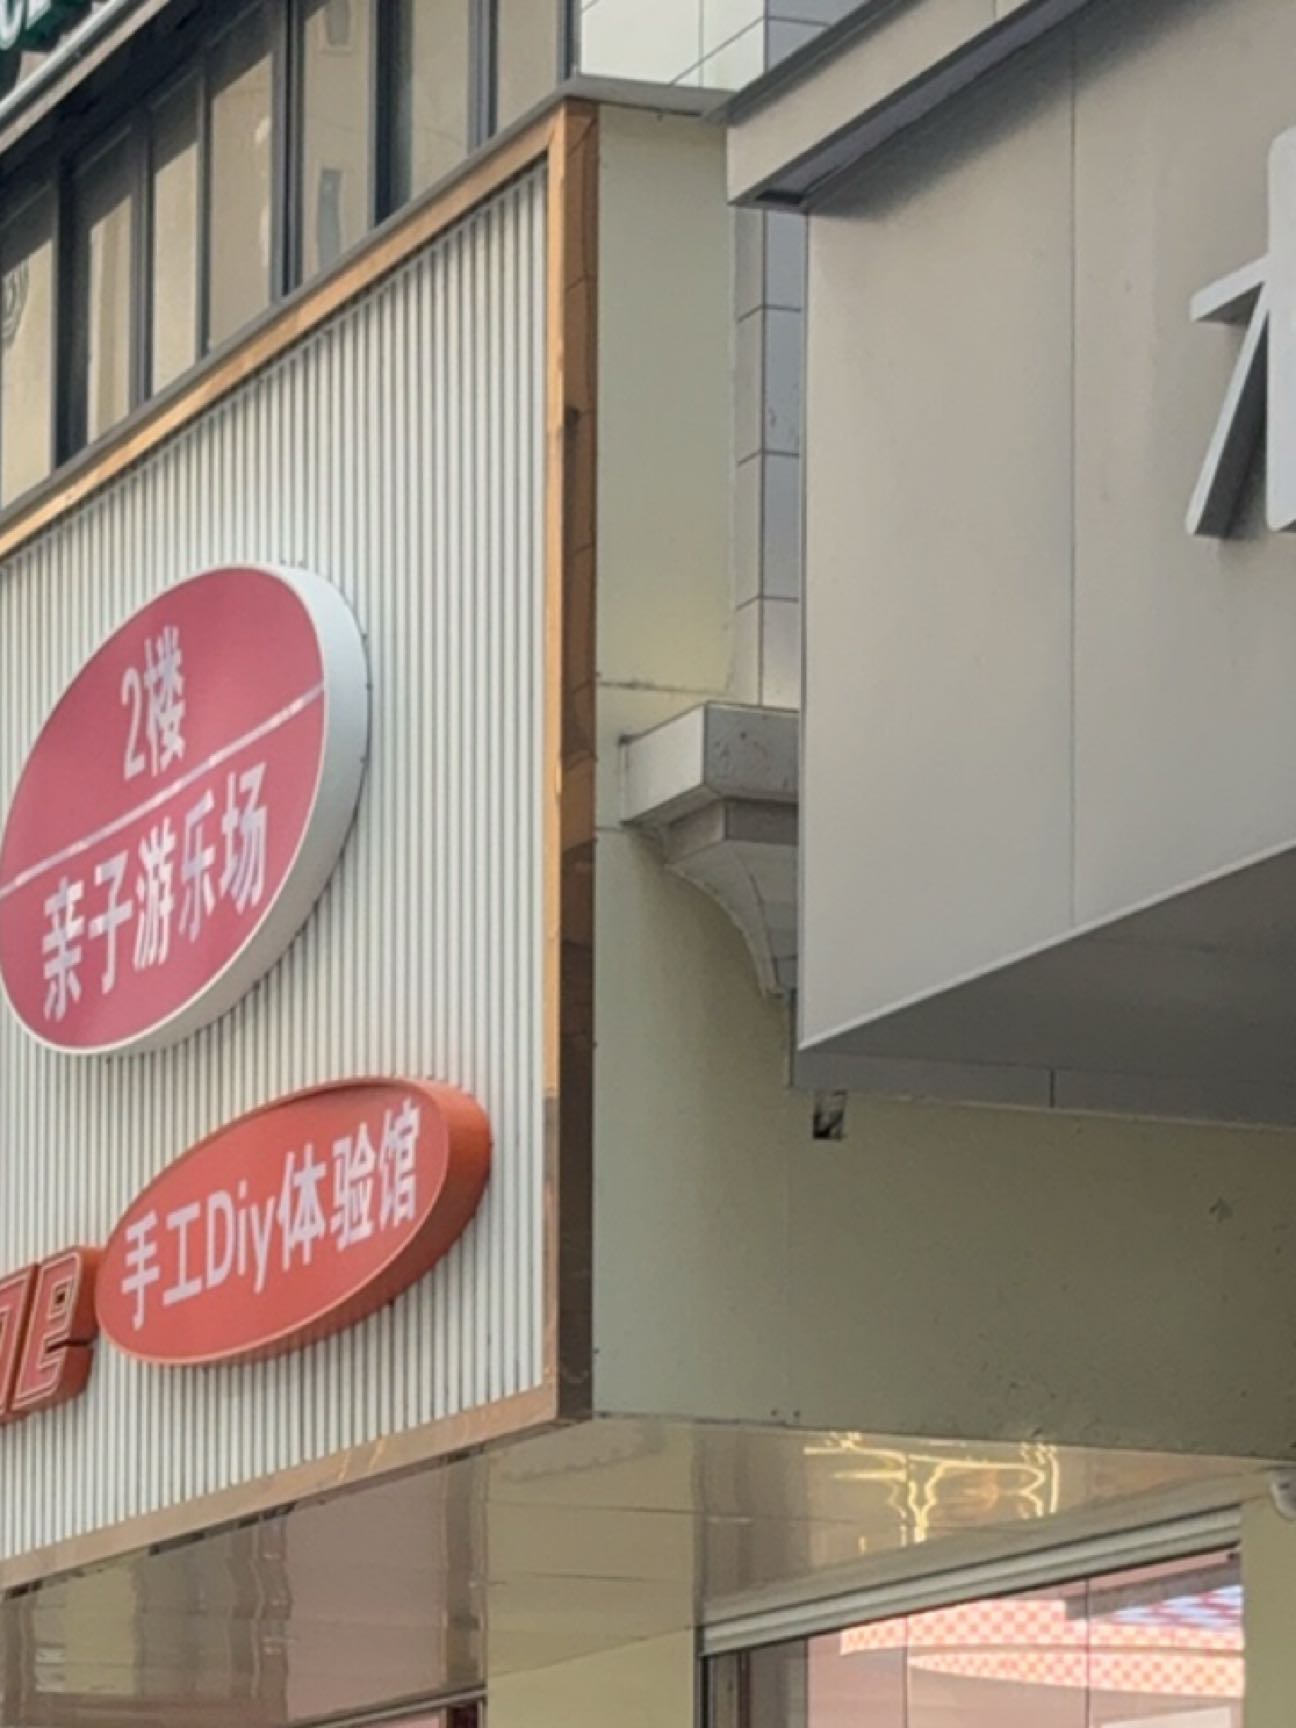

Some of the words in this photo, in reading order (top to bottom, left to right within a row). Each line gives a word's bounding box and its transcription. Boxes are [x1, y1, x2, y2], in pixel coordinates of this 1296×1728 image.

[119, 624, 186, 780] 2楼
[40, 762, 269, 1022] 亲子游乐场
[121, 1098, 421, 1330] 手工Diy体验馆
